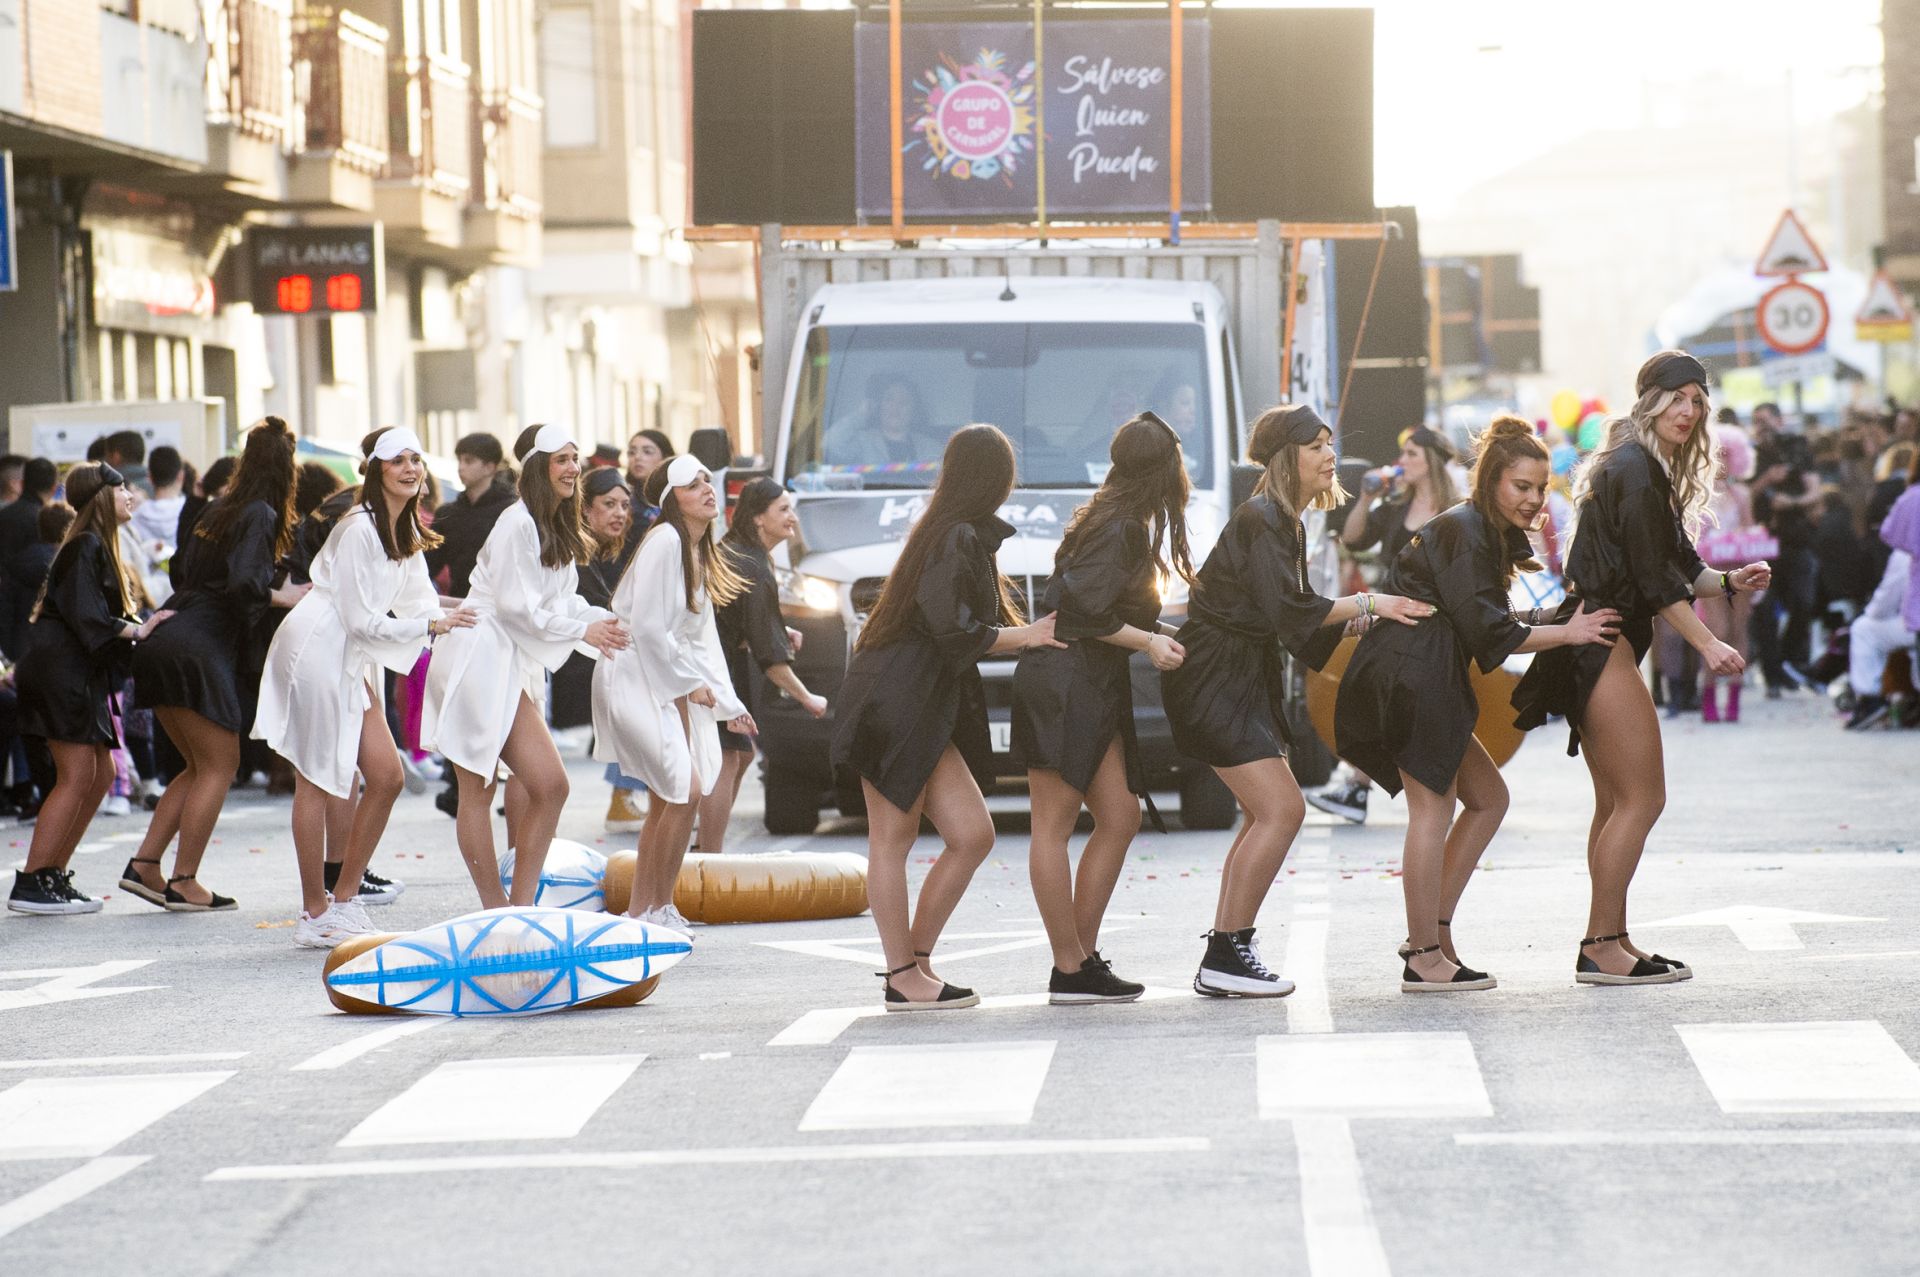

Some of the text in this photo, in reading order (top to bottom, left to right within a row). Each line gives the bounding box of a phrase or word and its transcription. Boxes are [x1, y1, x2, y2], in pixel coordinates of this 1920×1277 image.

[1057, 55, 1164, 94] Sálvese
[952, 98, 1001, 112] GRUPO
[1076, 94, 1149, 136] Quien
[947, 126, 1006, 147] CARNAVAL
[967, 116, 985, 130] DE
[1067, 142, 1157, 182] Pueda
[1773, 303, 1814, 330] 30
